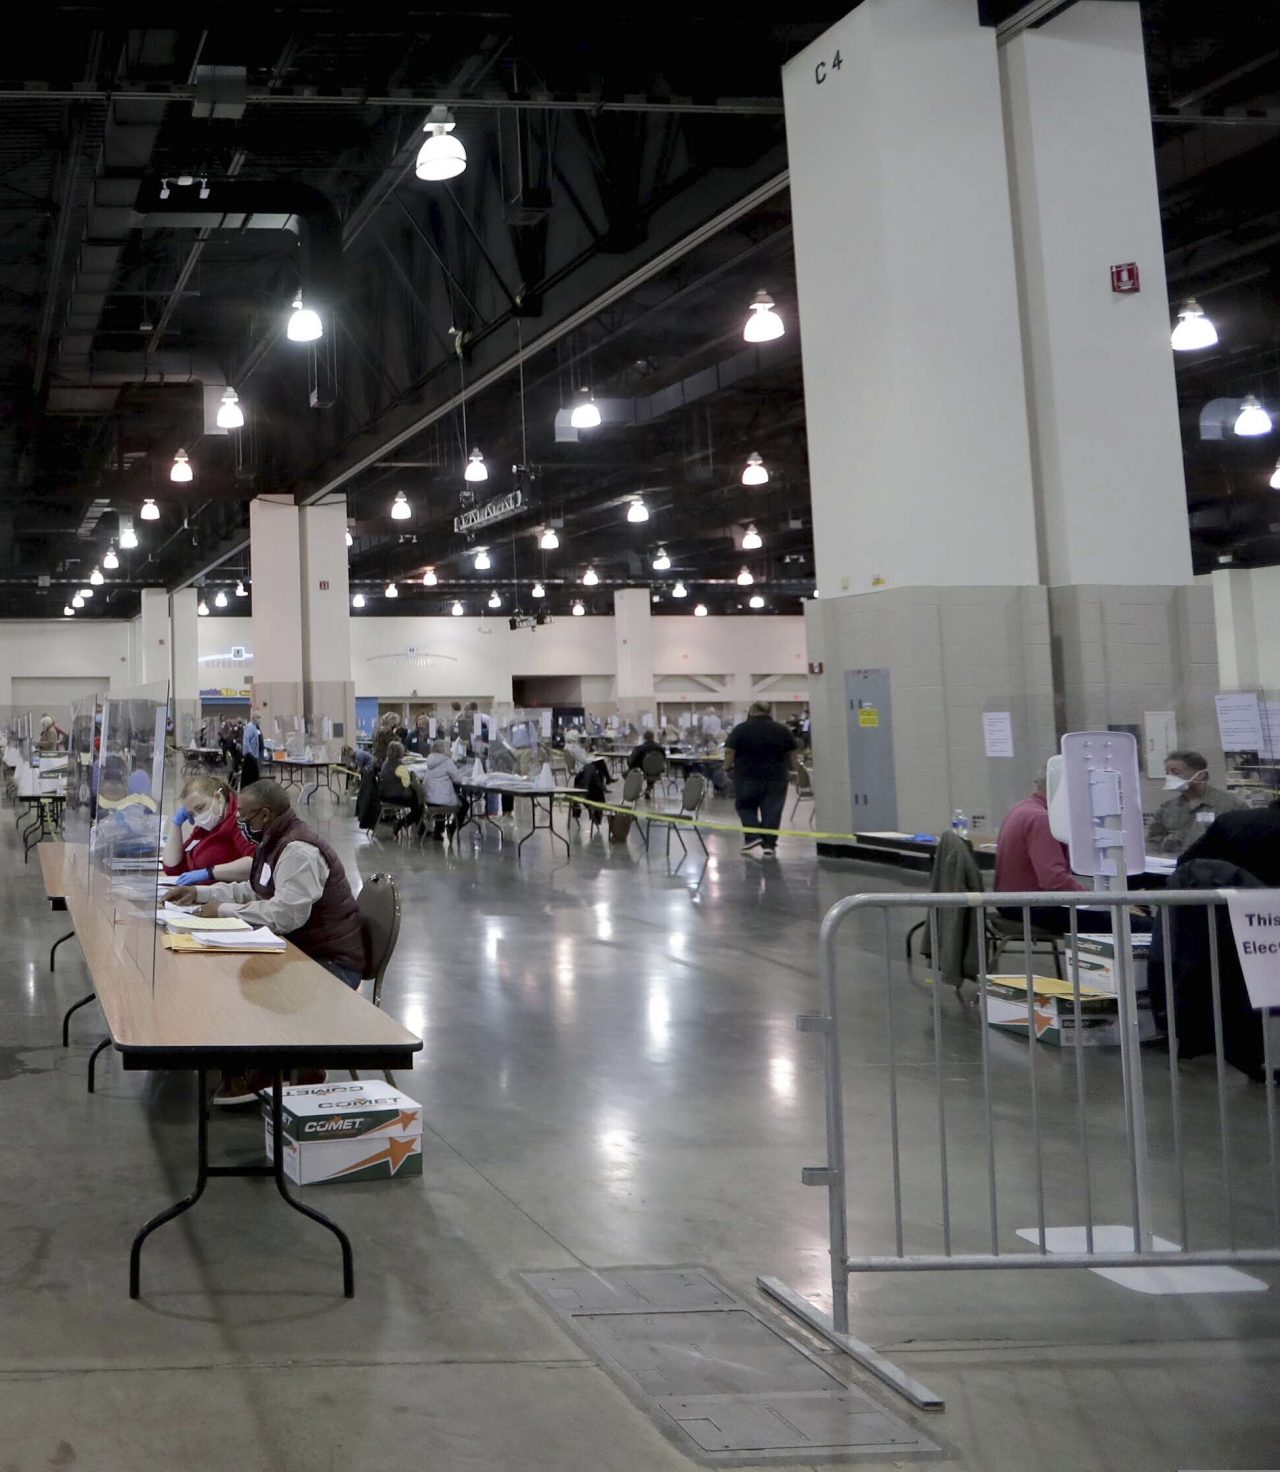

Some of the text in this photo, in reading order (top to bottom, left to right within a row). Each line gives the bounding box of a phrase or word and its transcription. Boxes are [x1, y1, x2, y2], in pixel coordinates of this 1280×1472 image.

[1244, 913, 1280, 927] This
[1242, 940, 1280, 955] Elec
[317, 1097, 402, 1109] COMET
[304, 1118, 365, 1133] COMET
